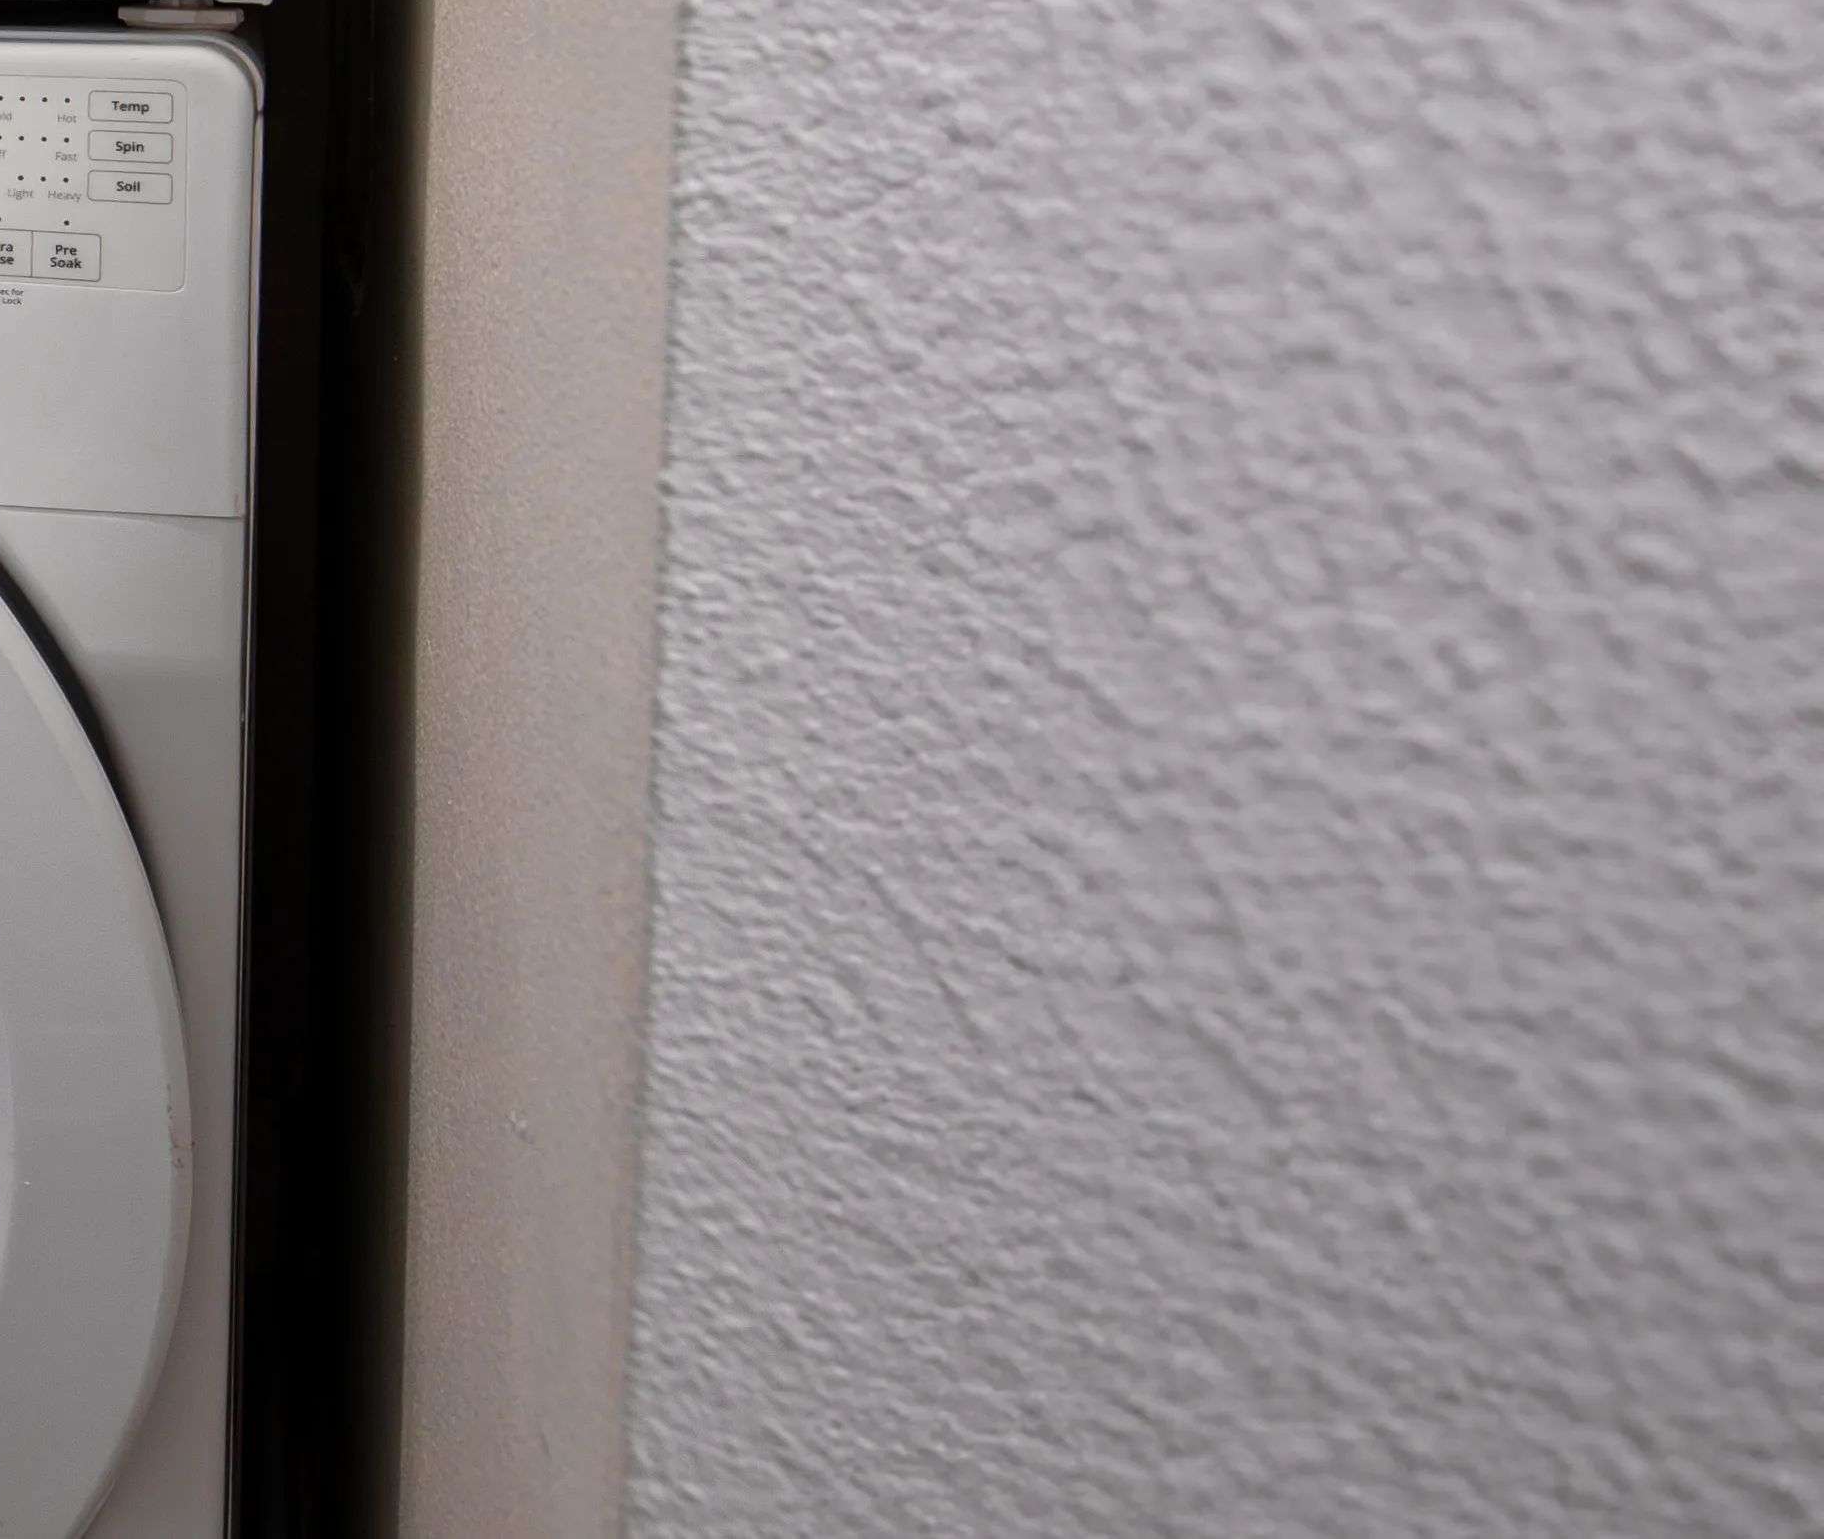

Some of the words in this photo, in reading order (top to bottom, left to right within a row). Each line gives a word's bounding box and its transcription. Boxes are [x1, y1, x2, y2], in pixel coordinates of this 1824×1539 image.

[111, 100, 150, 114] Temp
[57, 114, 77, 123] Hot
[115, 141, 145, 154] Spin
[55, 152, 78, 162] Fast
[116, 181, 141, 192] Soil
[7, 188, 34, 200] Light
[48, 190, 82, 203] Heavy
[55, 244, 77, 255] Pre
[49, 257, 82, 269] Soak
[2, 297, 23, 306] Lock
